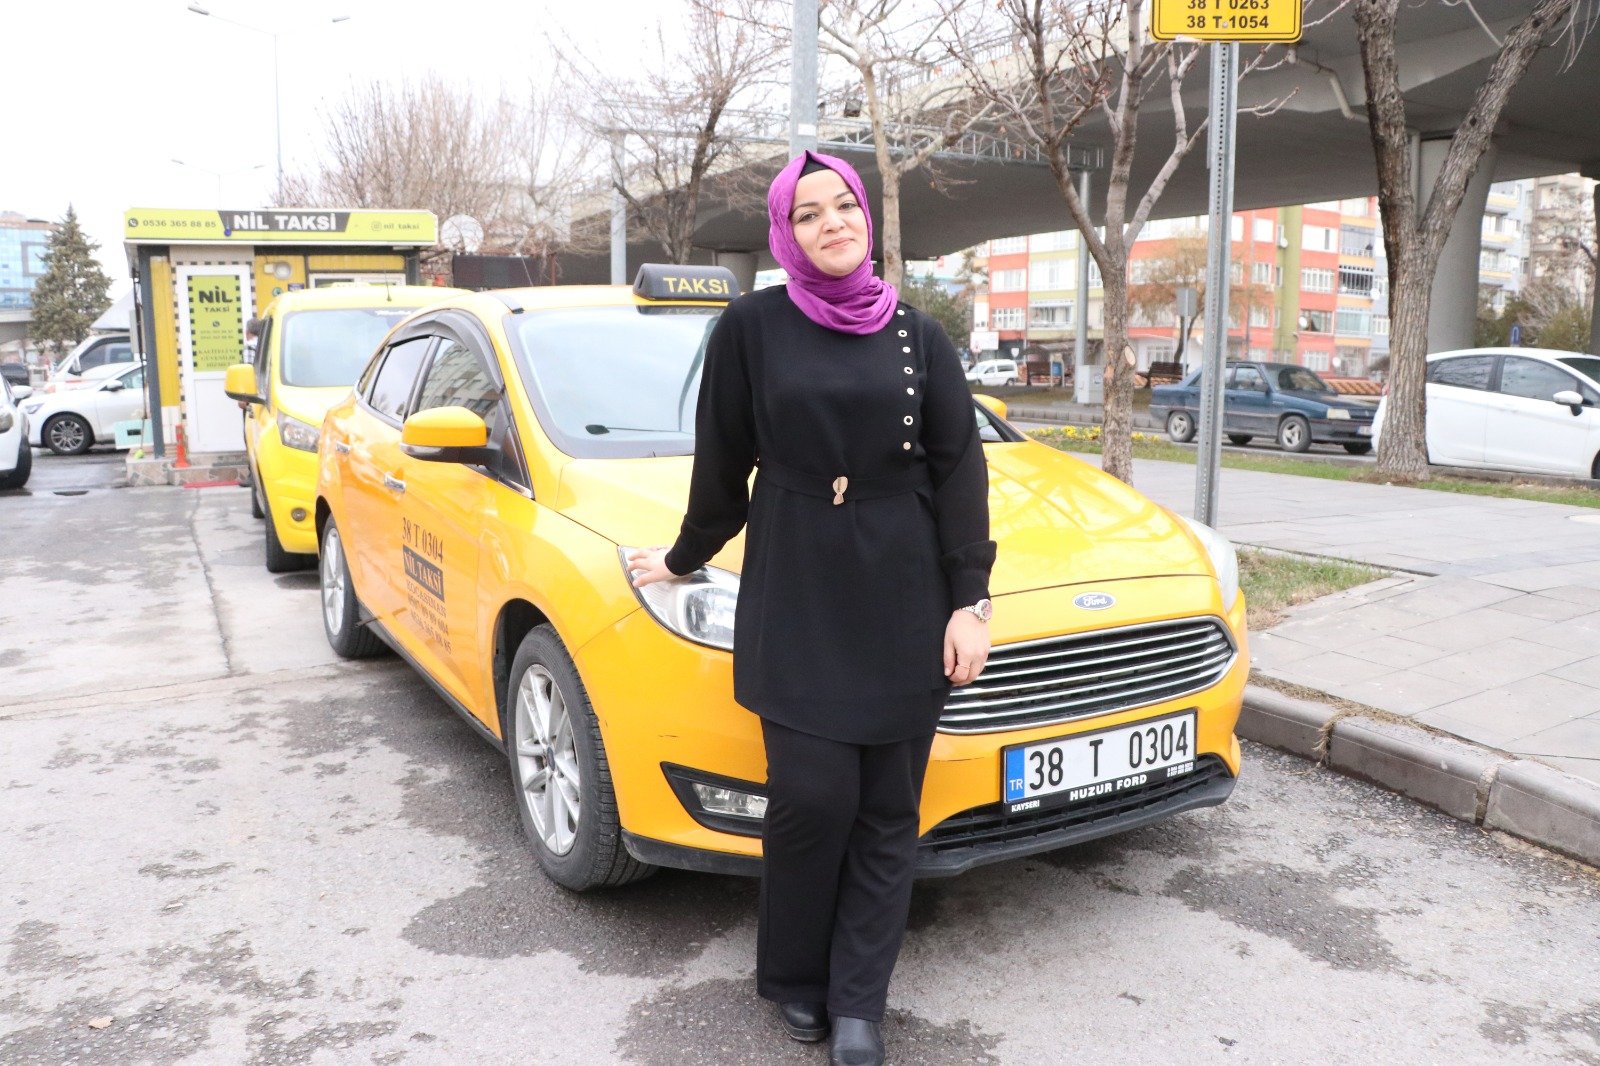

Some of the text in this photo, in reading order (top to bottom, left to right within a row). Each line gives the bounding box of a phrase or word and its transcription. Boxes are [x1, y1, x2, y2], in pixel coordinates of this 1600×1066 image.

[1187, 0, 1206, 10] 38
[1187, 15, 1269, 29] 38 T 1054
[143, 219, 167, 227] 0536
[233, 212, 337, 231] NİL TAKSİ
[198, 285, 233, 303] NİL
[402, 516, 444, 564] 38 T 0304
[417, 561, 443, 596] TAKSİ
[1029, 720, 1188, 790] 38 T 0304
[1009, 778, 1024, 791] TR
[1070, 774, 1147, 801] HUZUR FORD
